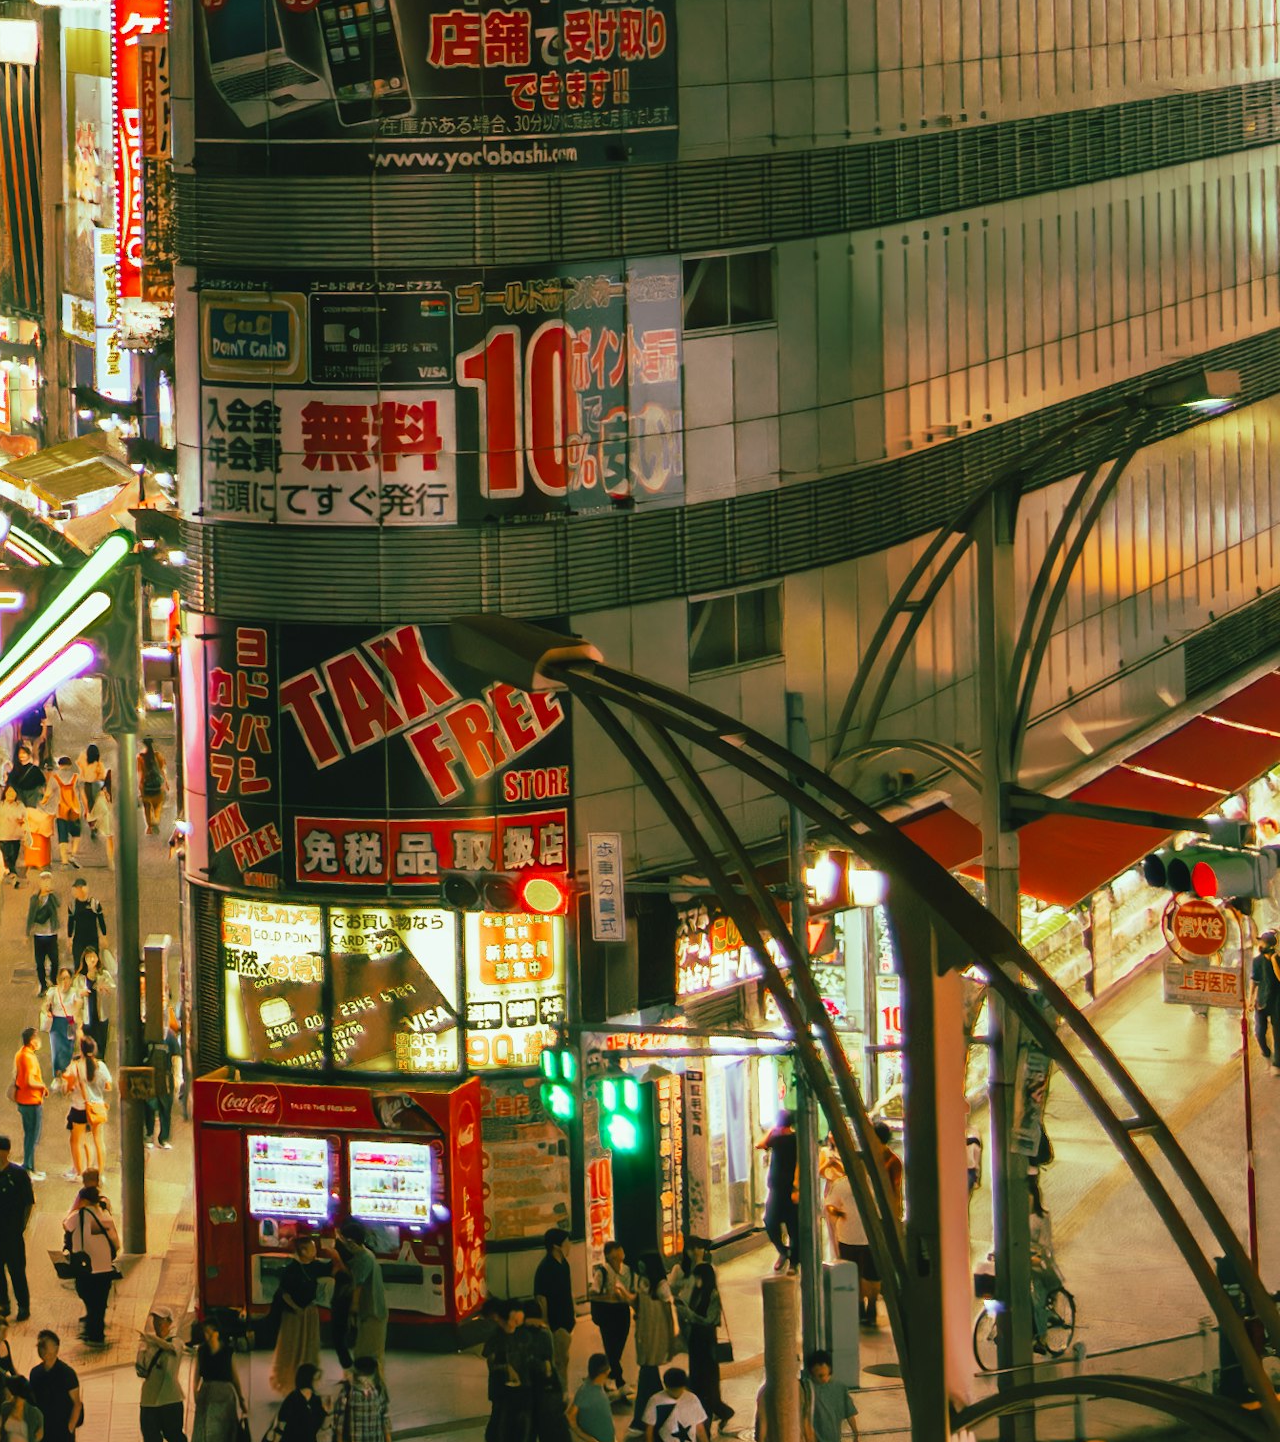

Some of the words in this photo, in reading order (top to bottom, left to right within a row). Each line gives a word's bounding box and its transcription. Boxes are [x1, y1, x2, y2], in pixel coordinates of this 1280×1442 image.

[427, 7, 667, 69] 店舗で受け取り
[418, 366, 448, 378] VISA
[207, 397, 282, 434] 入会金
[301, 400, 442, 472] 無料
[207, 436, 282, 474] 年会費
[207, 478, 449, 516] 店頭にてすぐ発行
[236, 626, 272, 795] ヨドバシ
[278, 624, 464, 770] TAX
[209, 665, 235, 794] カメラ
[403, 681, 565, 805] FREE
[503, 765, 570, 802] STORE
[208, 802, 250, 853] TAX
[230, 822, 283, 872] FREE
[302, 822, 567, 876] 免税品取扱店
[331, 914, 444, 931] でお買い物なら
[340, 997, 375, 1016] 2345
[408, 1005, 451, 1032] VISA
[221, 1092, 278, 1114] Coca-Cola
